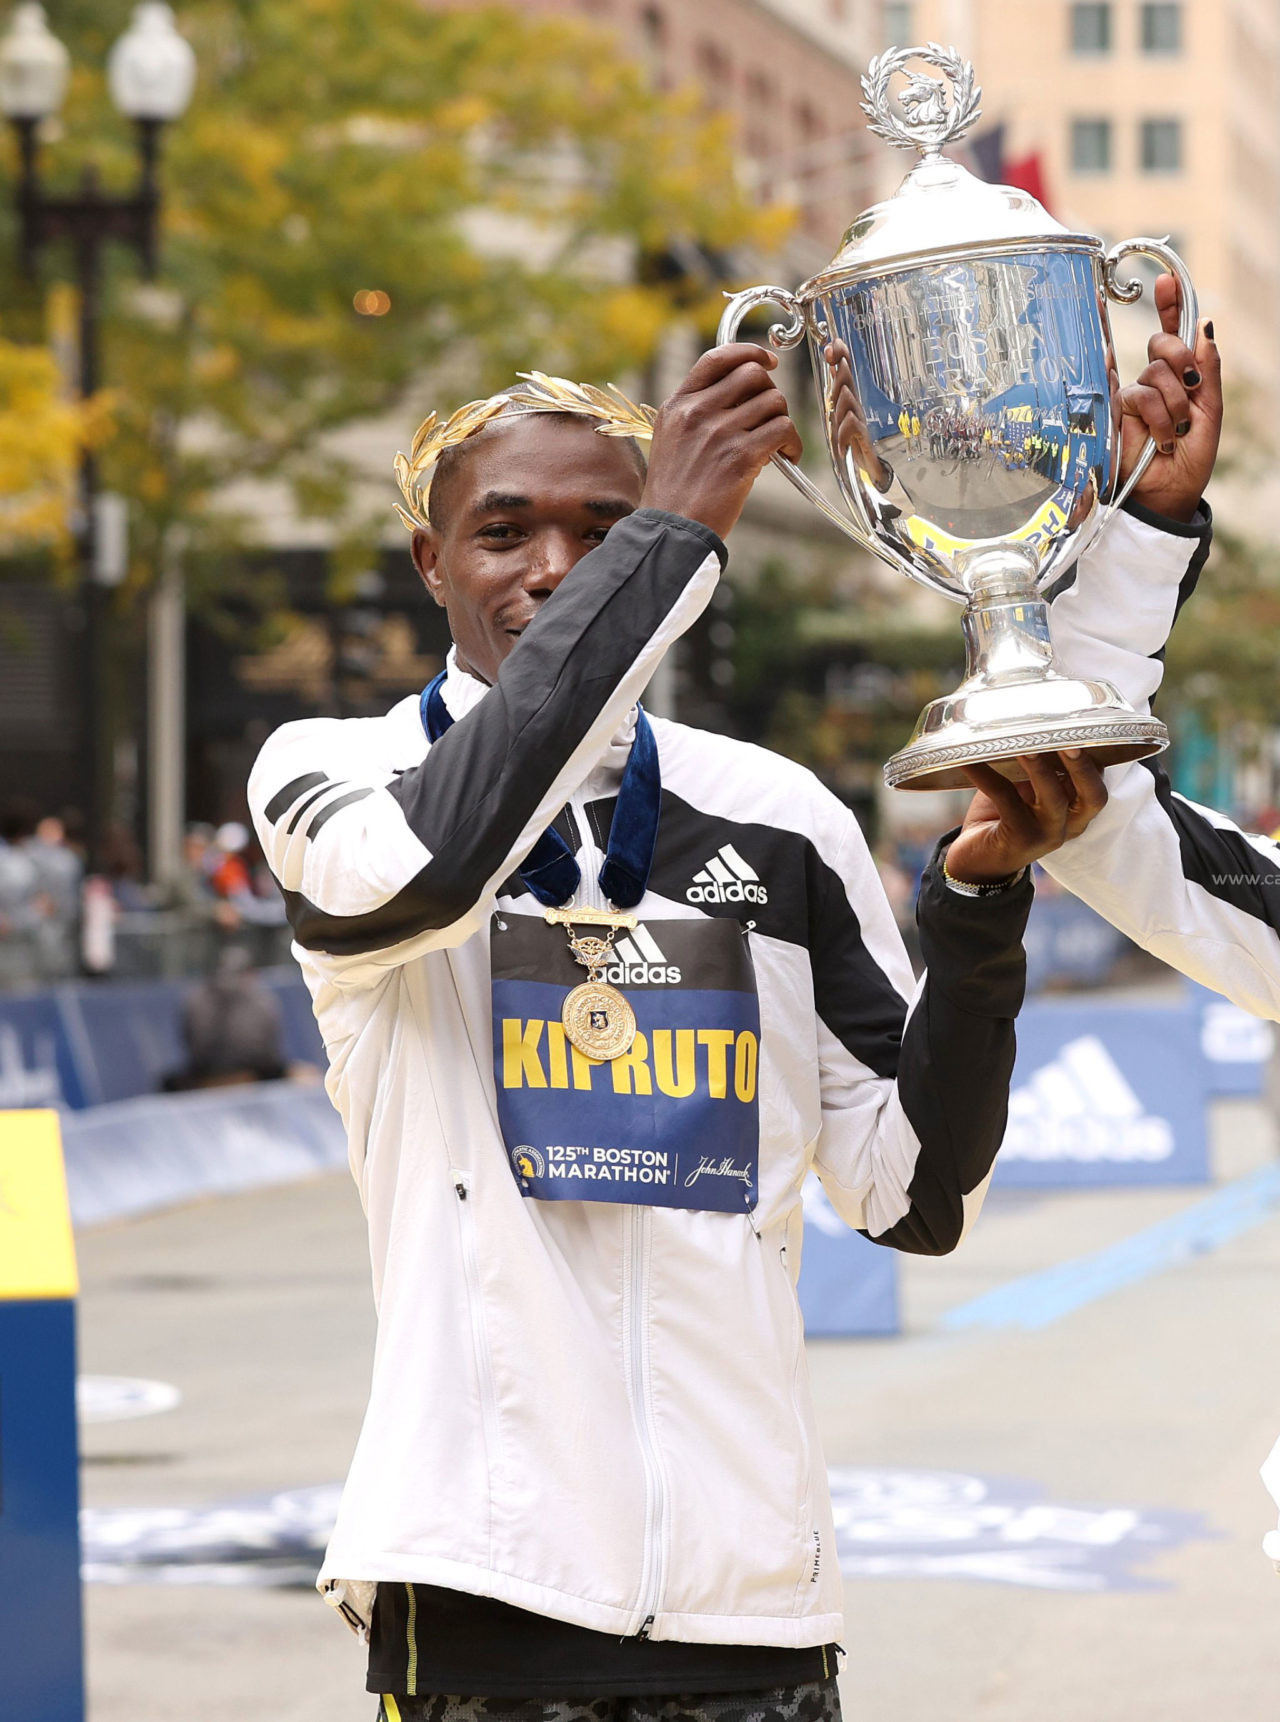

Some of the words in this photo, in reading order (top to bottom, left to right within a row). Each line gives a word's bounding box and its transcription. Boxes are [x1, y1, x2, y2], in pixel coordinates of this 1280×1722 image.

[685, 880, 768, 905] adidas
[594, 961, 682, 984] adidas
[546, 1145, 589, 1161] 125TH
[593, 1147, 668, 1167] BOSTON
[548, 1163, 668, 1185] MARATHON
